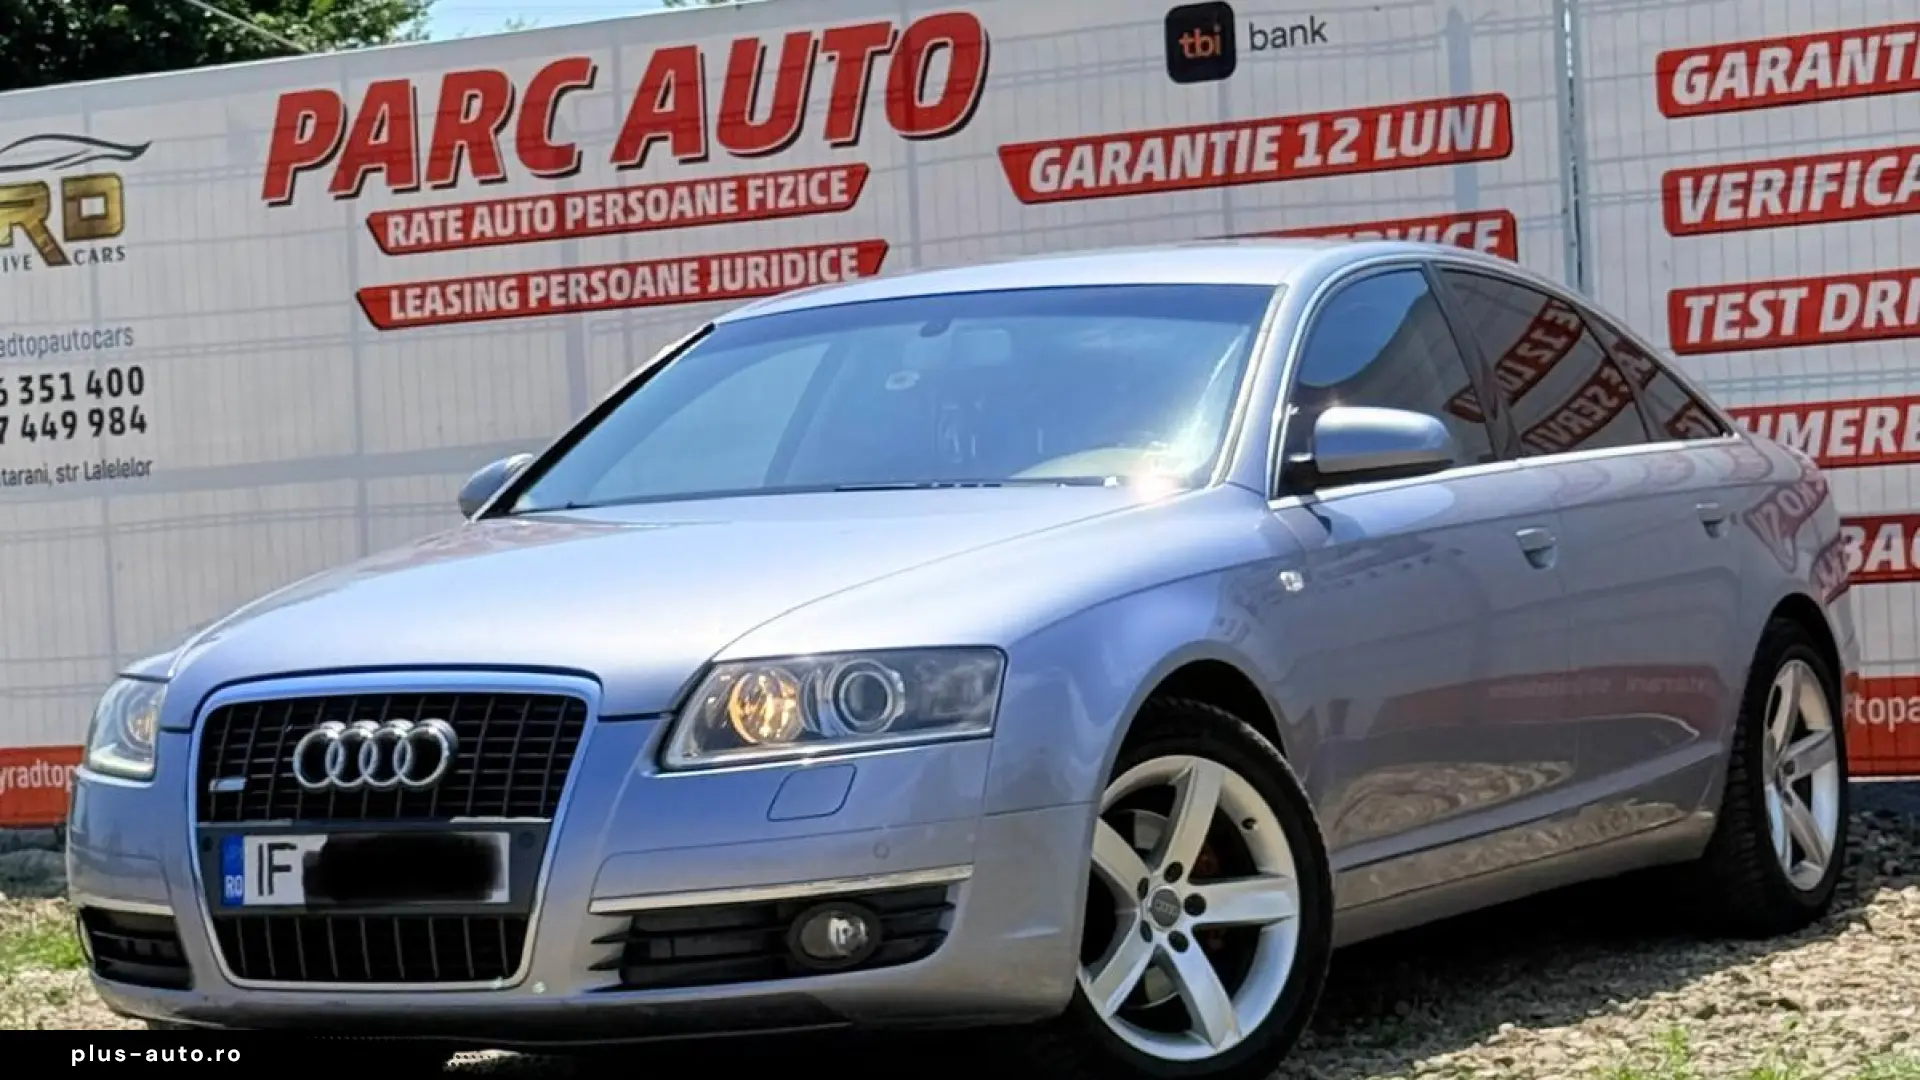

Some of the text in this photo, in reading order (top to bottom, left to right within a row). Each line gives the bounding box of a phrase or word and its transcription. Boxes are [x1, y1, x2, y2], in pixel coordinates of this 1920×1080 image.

[1178, 15, 1328, 58] tbi bank
[262, 11, 990, 206] PARC AUTO
[1029, 102, 1497, 193] GARANTIE 12 LUNI
[386, 169, 848, 248] RATE AUTO PERSOANE FIZICE
[1678, 154, 1920, 225] VERIFICA
[73, 245, 126, 267] CARS
[390, 246, 859, 321] LEASING PERSOANE JURIDICE
[1683, 275, 1920, 345] TEST DRI
[18, 371, 75, 405] 351
[86, 364, 145, 399] 400
[0, 404, 147, 445] 7 449 984
[0, 462, 53, 488] tarani,
[56, 463, 80, 483] str
[225, 875, 243, 898] RO
[257, 842, 299, 897] IF
